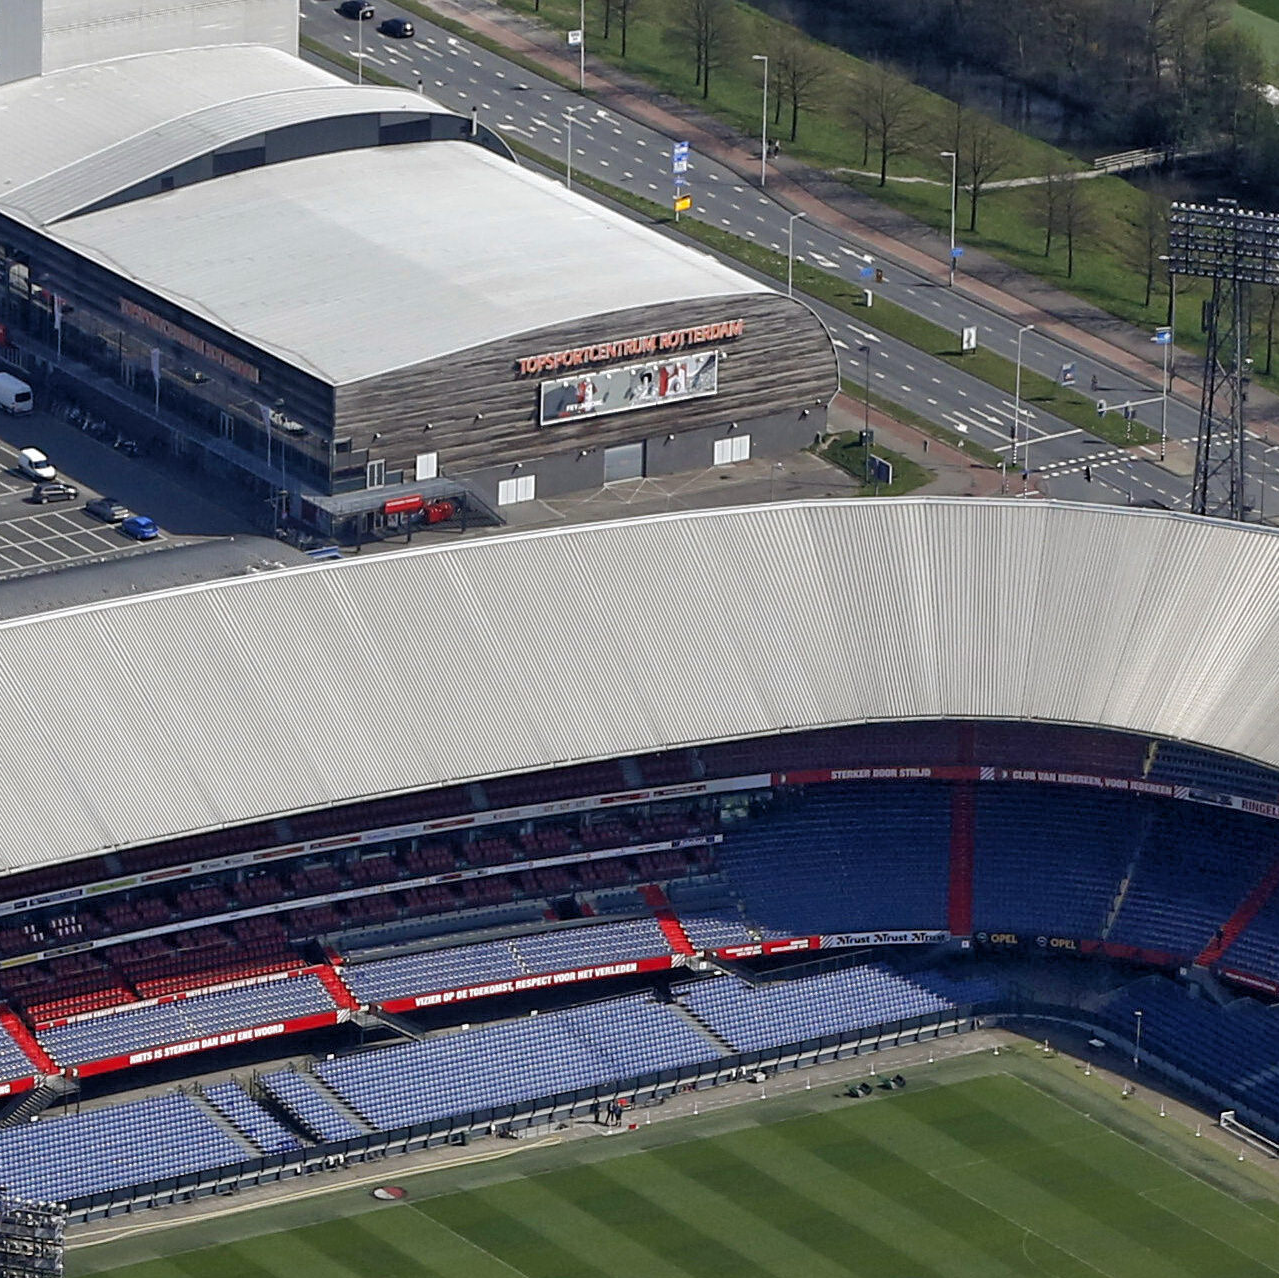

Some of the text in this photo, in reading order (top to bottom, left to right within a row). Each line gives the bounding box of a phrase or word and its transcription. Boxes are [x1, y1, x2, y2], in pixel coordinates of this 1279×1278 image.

[519, 319, 745, 374] TOPSPORTCENTRUM ROTTERDAM
[831, 768, 931, 780] STERKER DOOR STRIJD
[1012, 770, 1036, 780] CLUB
[1038, 772, 1056, 782] VAN
[990, 933, 1018, 944] OPEL
[1050, 938, 1076, 950] OPEL
[443, 992, 454, 1002] OP
[456, 989, 467, 1000] DE
[468, 981, 514, 997] TOEKOMST,
[515, 976, 552, 990] RESPECT
[553, 972, 575, 983] VOOR
[577, 969, 593, 980] HET
[595, 962, 637, 977] VERLEDEN
[129, 1051, 153, 1065] NIETS
[154, 1049, 163, 1060] IS
[164, 1041, 199, 1057] STERKER
[201, 1036, 219, 1049] DAN
[220, 1033, 236, 1045] DAT
[254, 1024, 284, 1038] WOORD
